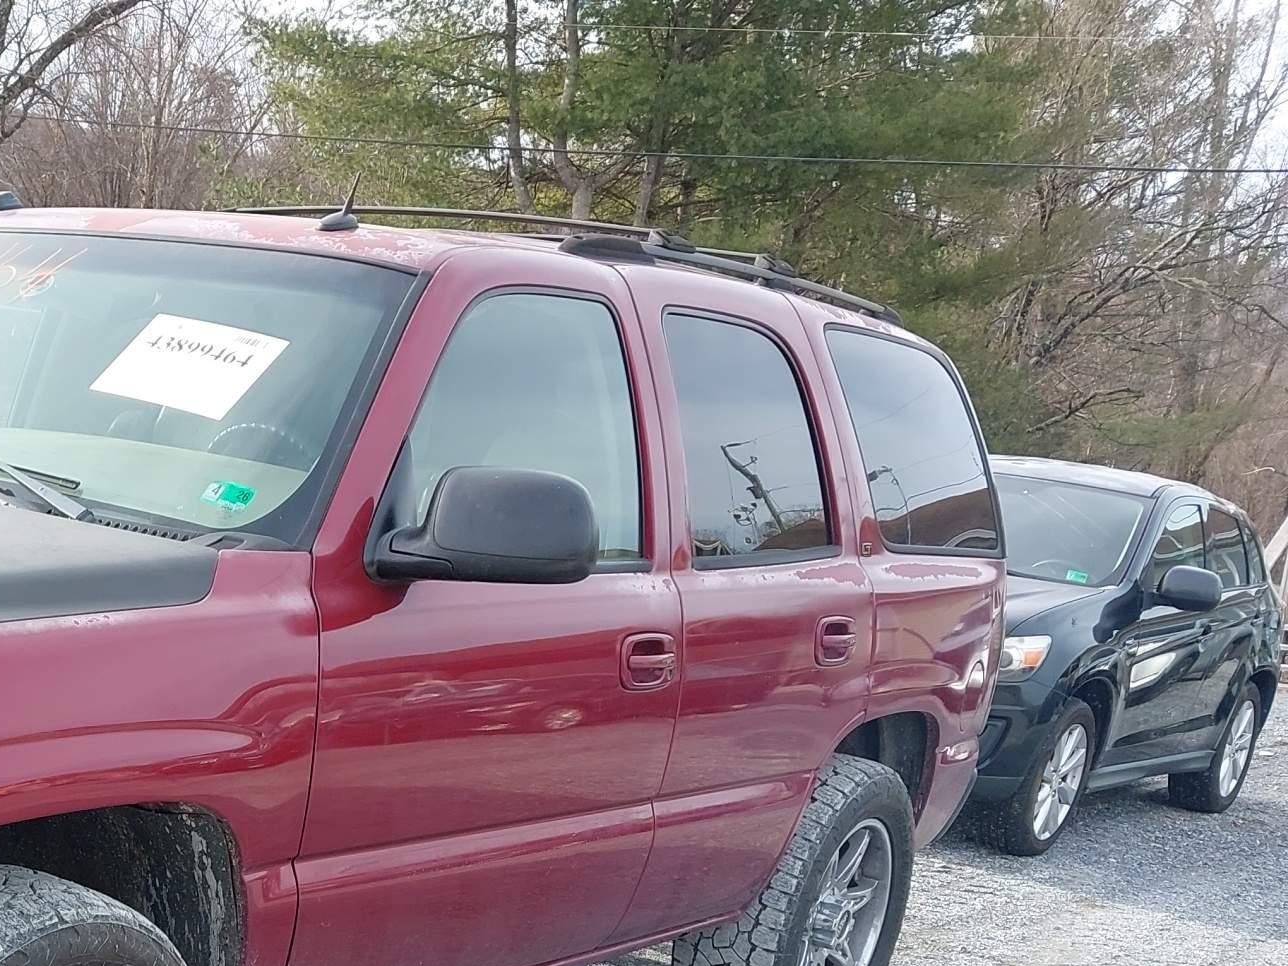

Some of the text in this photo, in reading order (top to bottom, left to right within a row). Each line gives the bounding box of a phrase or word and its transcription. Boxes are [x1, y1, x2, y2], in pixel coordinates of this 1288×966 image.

[146, 335, 254, 368] 43899464
[211, 484, 222, 496] 4
[236, 490, 251, 502] 26
